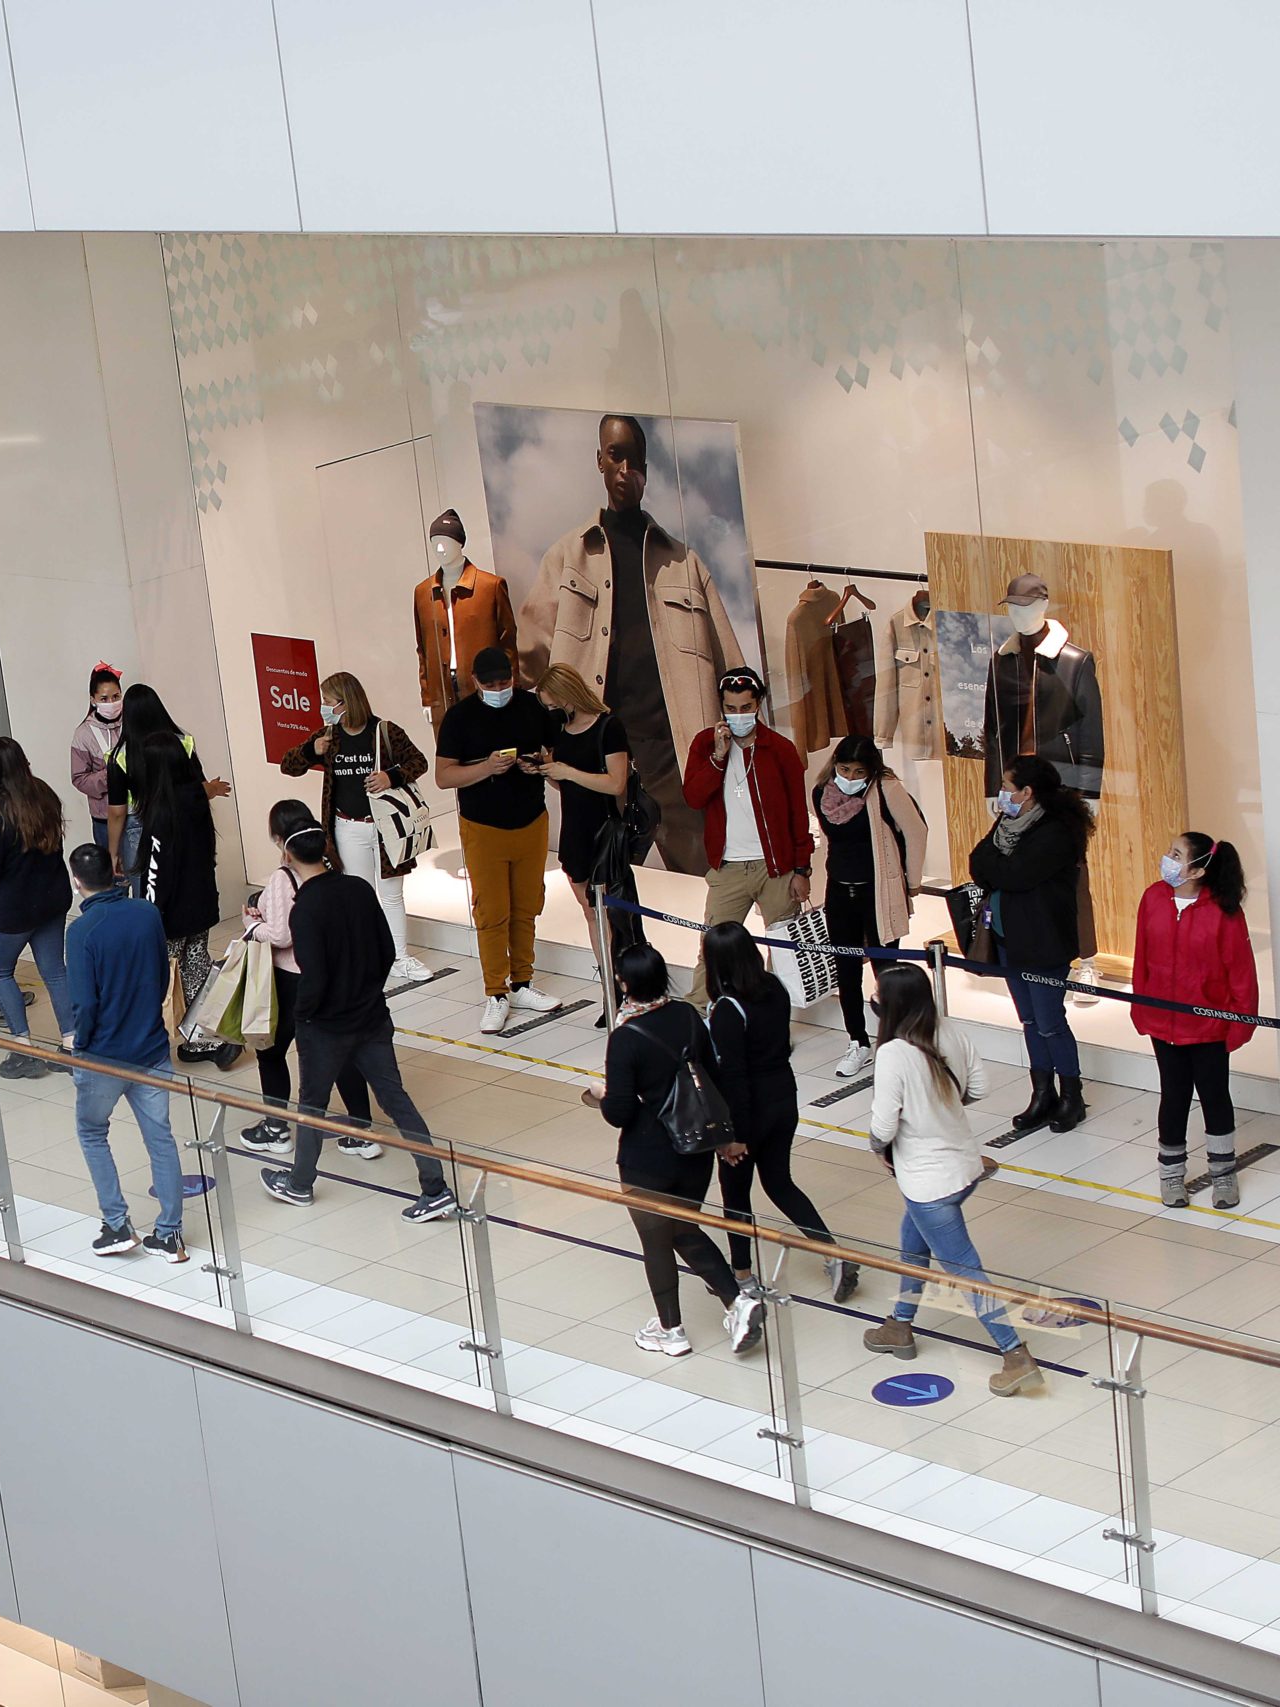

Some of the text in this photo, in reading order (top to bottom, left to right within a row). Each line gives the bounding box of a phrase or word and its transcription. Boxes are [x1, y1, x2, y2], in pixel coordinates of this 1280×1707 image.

[970, 643, 987, 654] Los
[269, 685, 311, 713] Sale
[334, 753, 357, 763] C'est
[334, 767, 353, 777] mon
[662, 914, 701, 931] COSTANERA
[796, 942, 865, 956] COSTANERA CENTER
[1021, 971, 1097, 995] COSTANERA CENTER
[1192, 1005, 1274, 1028] COSTANERA CENTER
